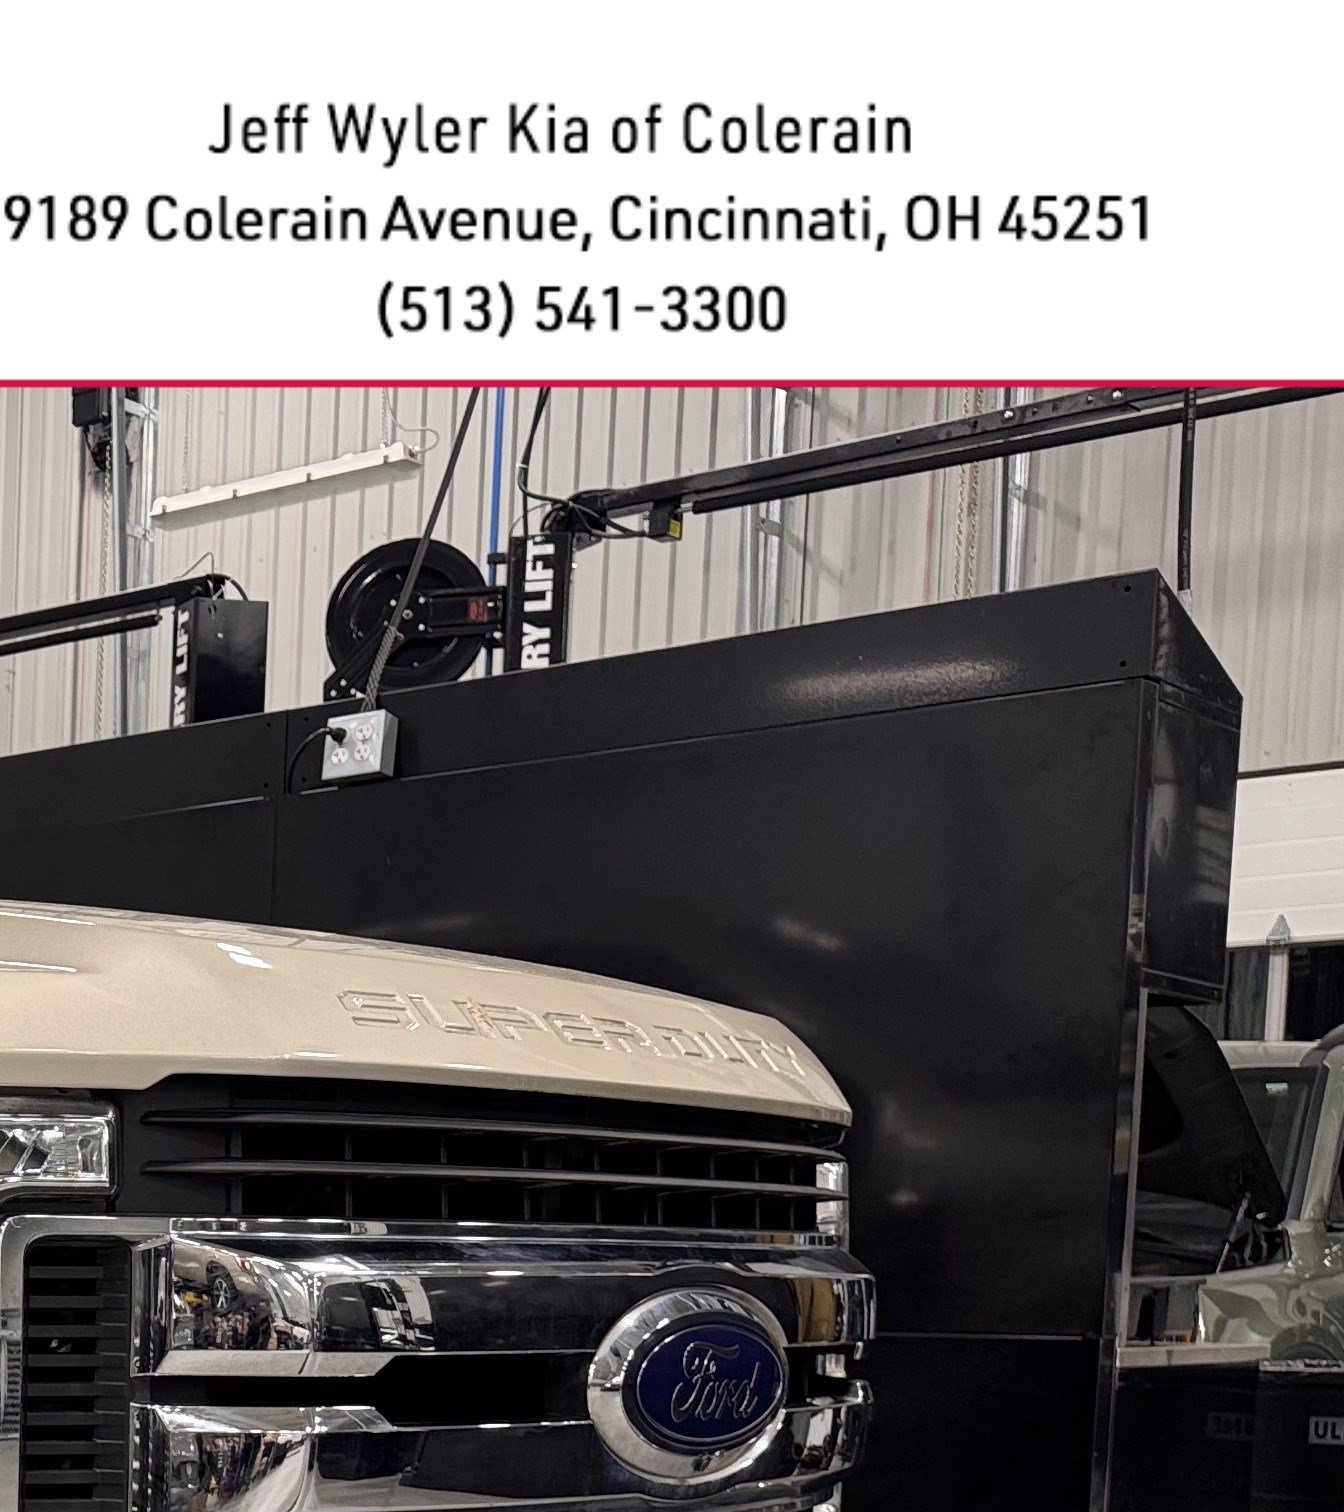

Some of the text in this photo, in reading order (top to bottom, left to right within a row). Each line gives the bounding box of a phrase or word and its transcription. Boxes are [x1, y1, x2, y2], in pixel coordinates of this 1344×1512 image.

[524, 539, 555, 612] LIFT
[176, 609, 190, 675] LIFT
[671, 1341, 762, 1423] Ford
